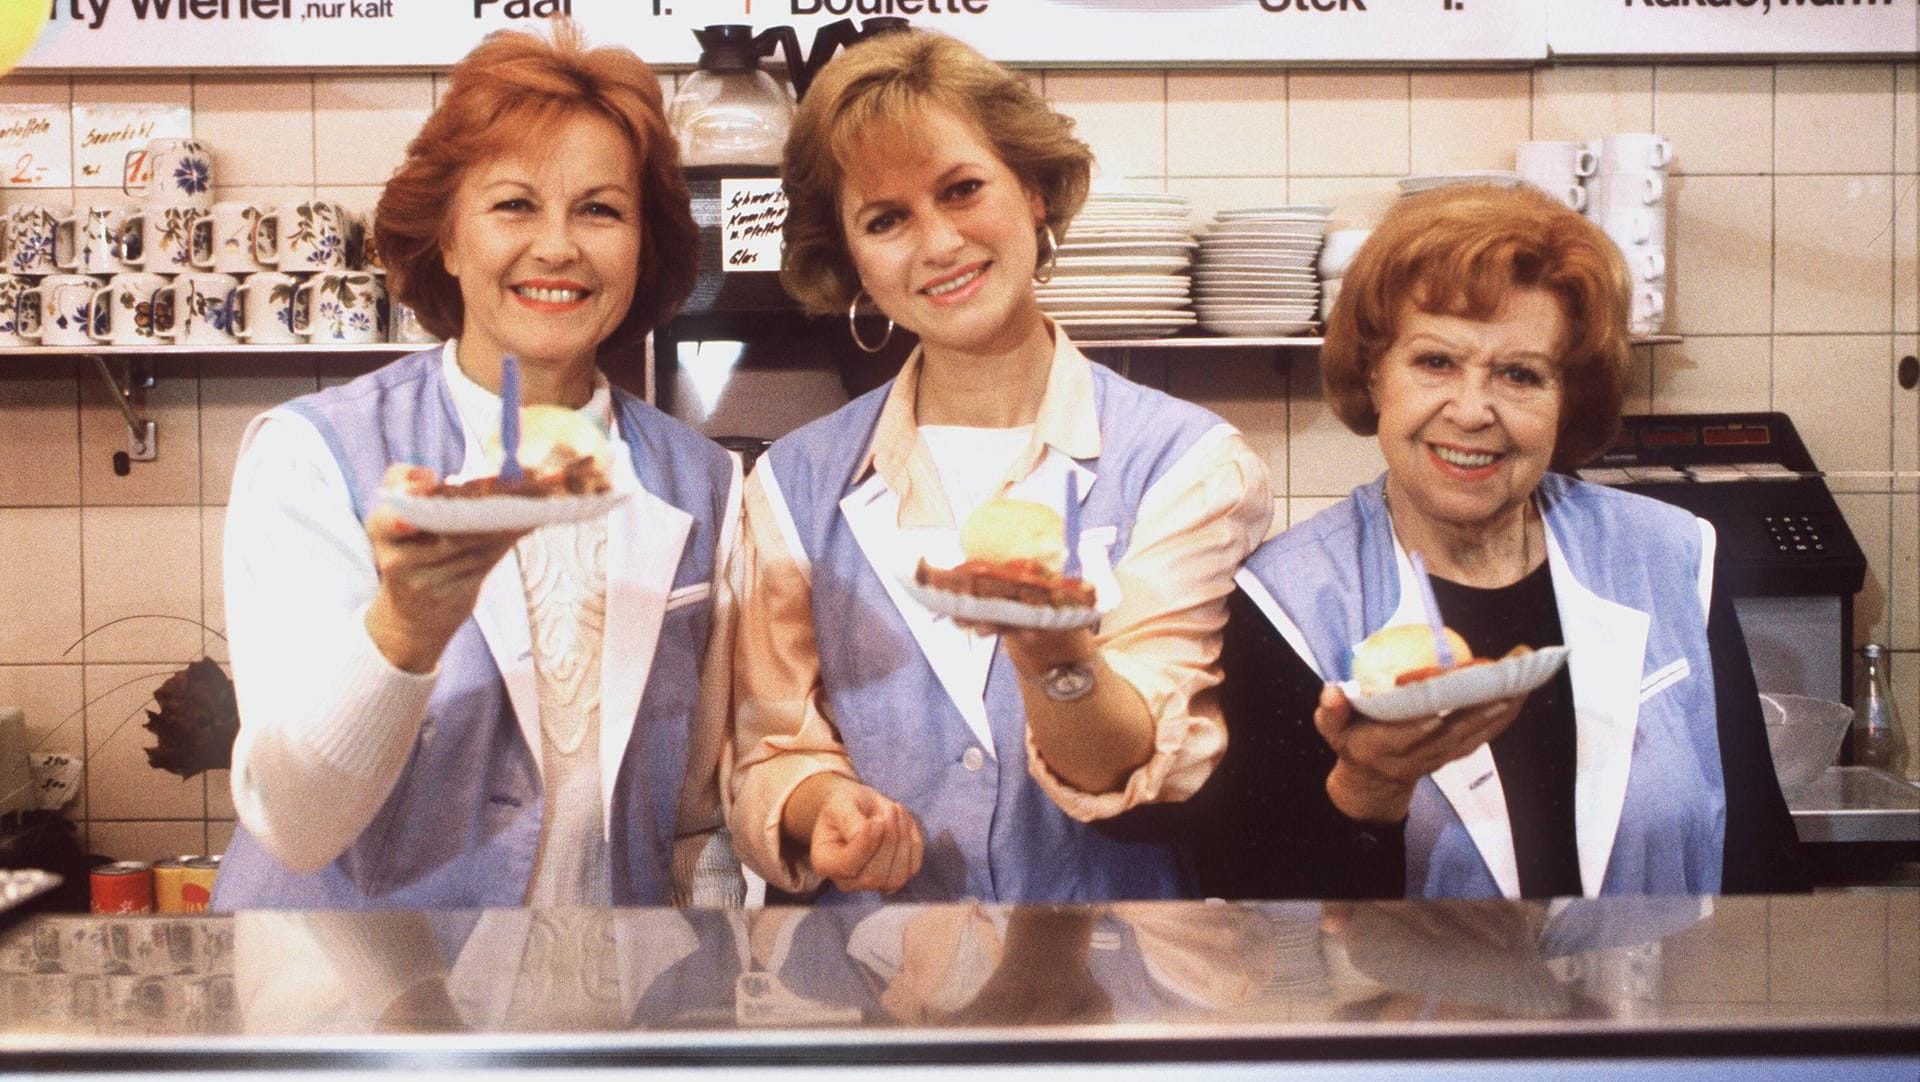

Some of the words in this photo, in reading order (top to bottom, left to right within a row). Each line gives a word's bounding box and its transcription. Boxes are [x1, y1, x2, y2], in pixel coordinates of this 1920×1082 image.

[130, 0, 292, 20] Wiener
[350, 0, 394, 18] kalt
[729, 249, 758, 267] Glas
